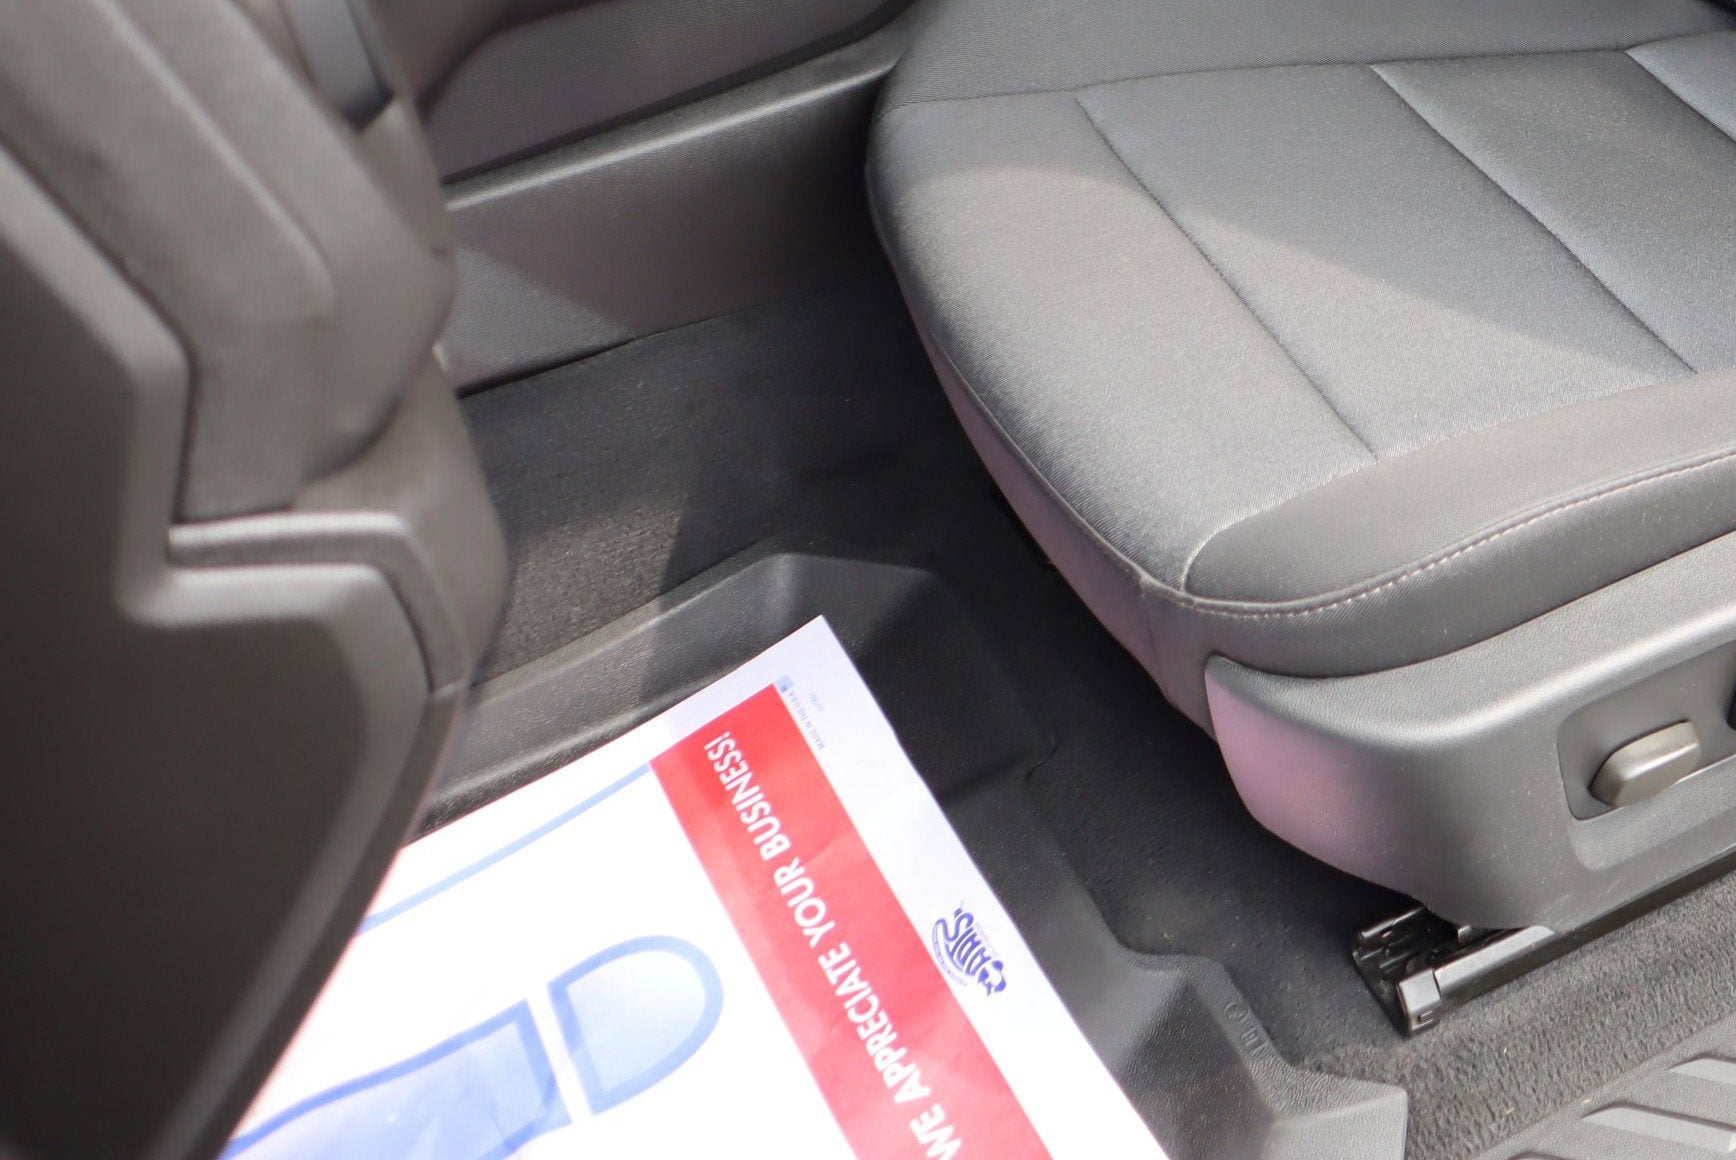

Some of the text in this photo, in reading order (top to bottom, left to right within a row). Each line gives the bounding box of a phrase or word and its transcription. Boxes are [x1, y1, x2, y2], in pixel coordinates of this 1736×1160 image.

[705, 731, 962, 1160] WE APPRECIATE YOUR BUSINESS!
